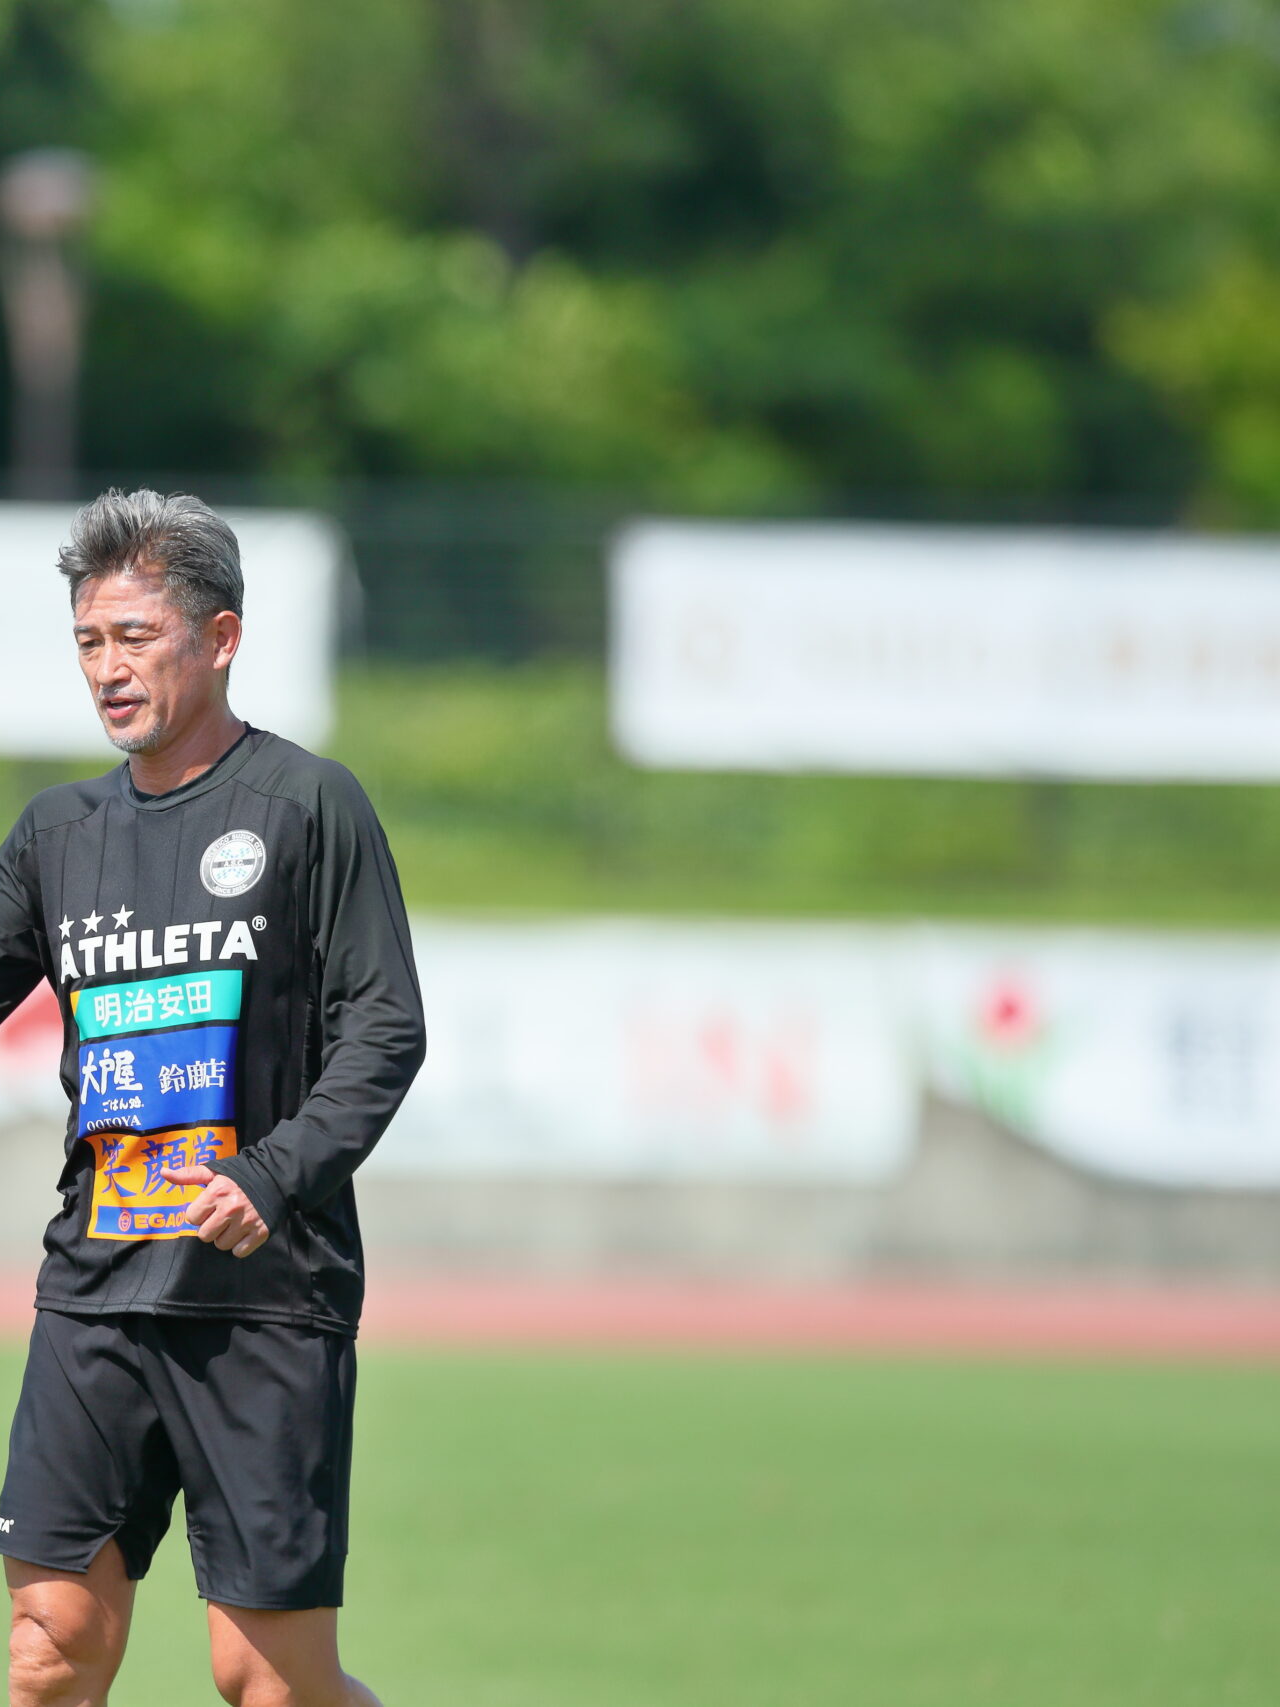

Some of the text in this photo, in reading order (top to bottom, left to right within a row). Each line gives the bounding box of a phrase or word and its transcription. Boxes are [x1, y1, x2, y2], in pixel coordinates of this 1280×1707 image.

[93, 979, 212, 1029] 明治安田
[80, 1047, 144, 1105] 大戸屋
[86, 1114, 142, 1132] OOTOYA
[133, 1210, 191, 1230] EGAO
